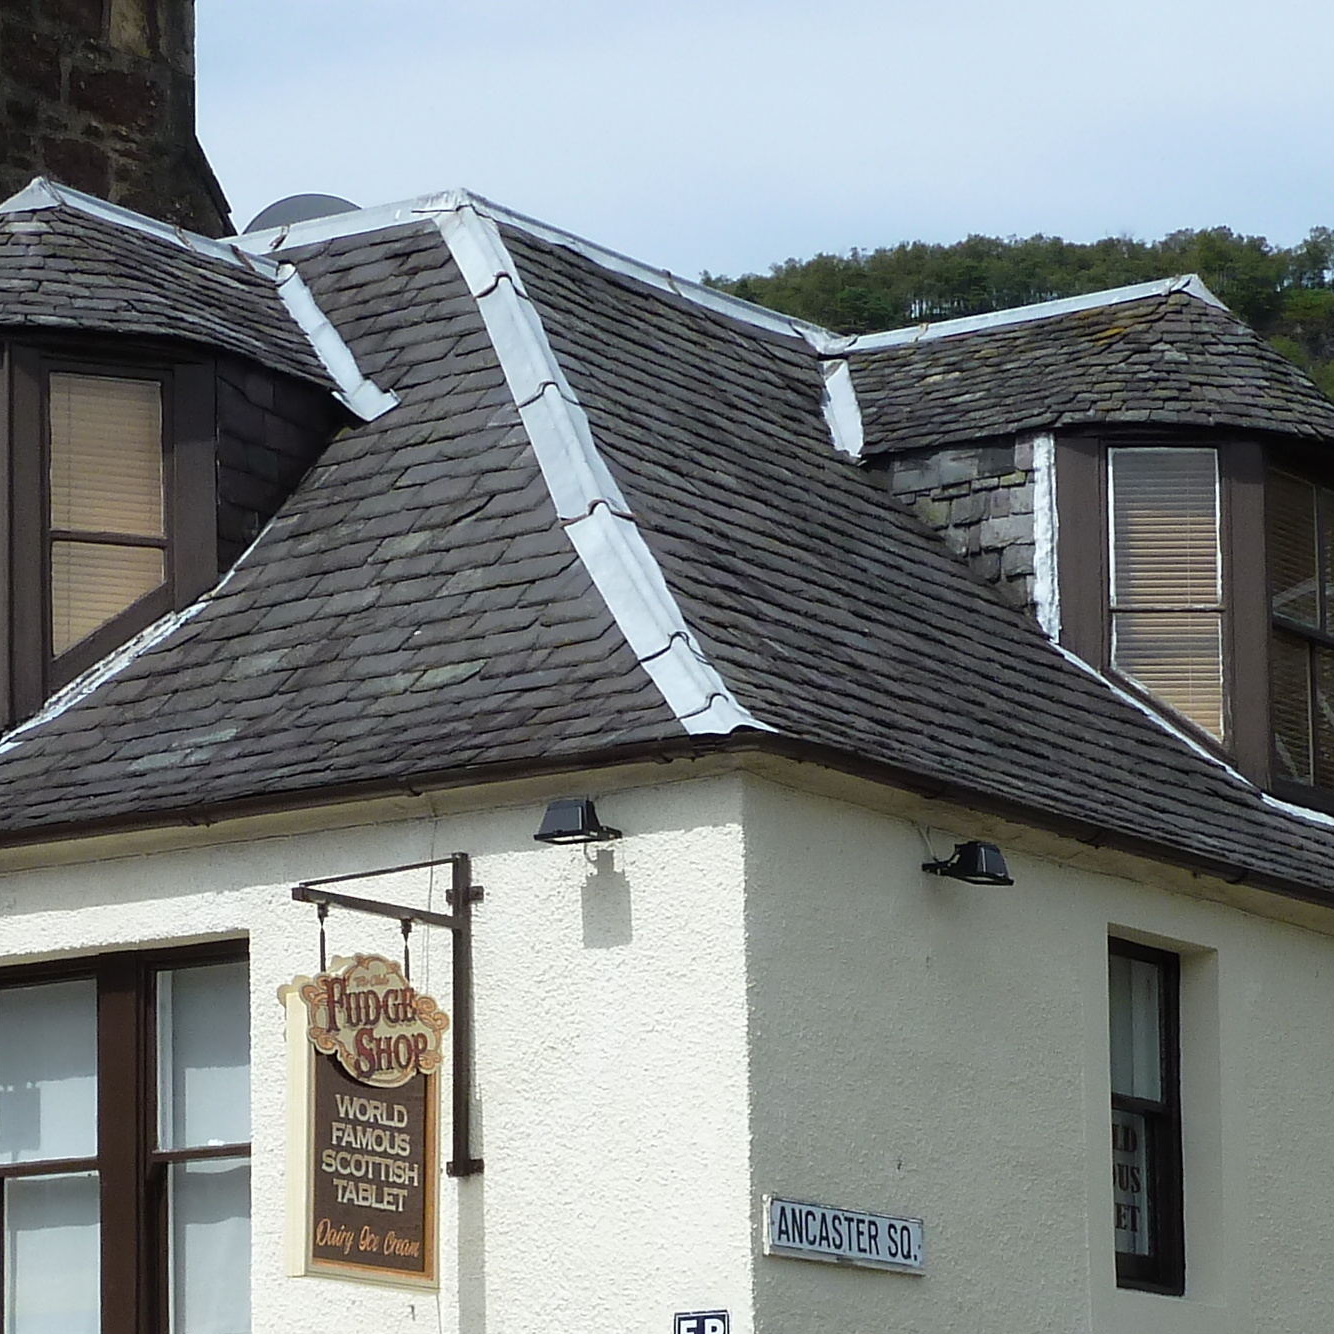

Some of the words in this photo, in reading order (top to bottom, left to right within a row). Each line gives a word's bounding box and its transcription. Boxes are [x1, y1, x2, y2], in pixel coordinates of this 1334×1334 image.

[323, 978, 417, 1033] FUDGE
[354, 1028, 428, 1079] SHOP
[335, 1094, 408, 1128] WORLD
[331, 1122, 410, 1156] FAMOUS
[321, 1149, 419, 1187] SCOTTISH
[333, 1178, 408, 1212] TABLET
[316, 1218, 355, 1254] Dairy
[359, 1225, 379, 1251] Ice
[383, 1230, 420, 1258] Cream
[777, 1205, 880, 1256] ANCASTER
[888, 1223, 919, 1263] SQ.
